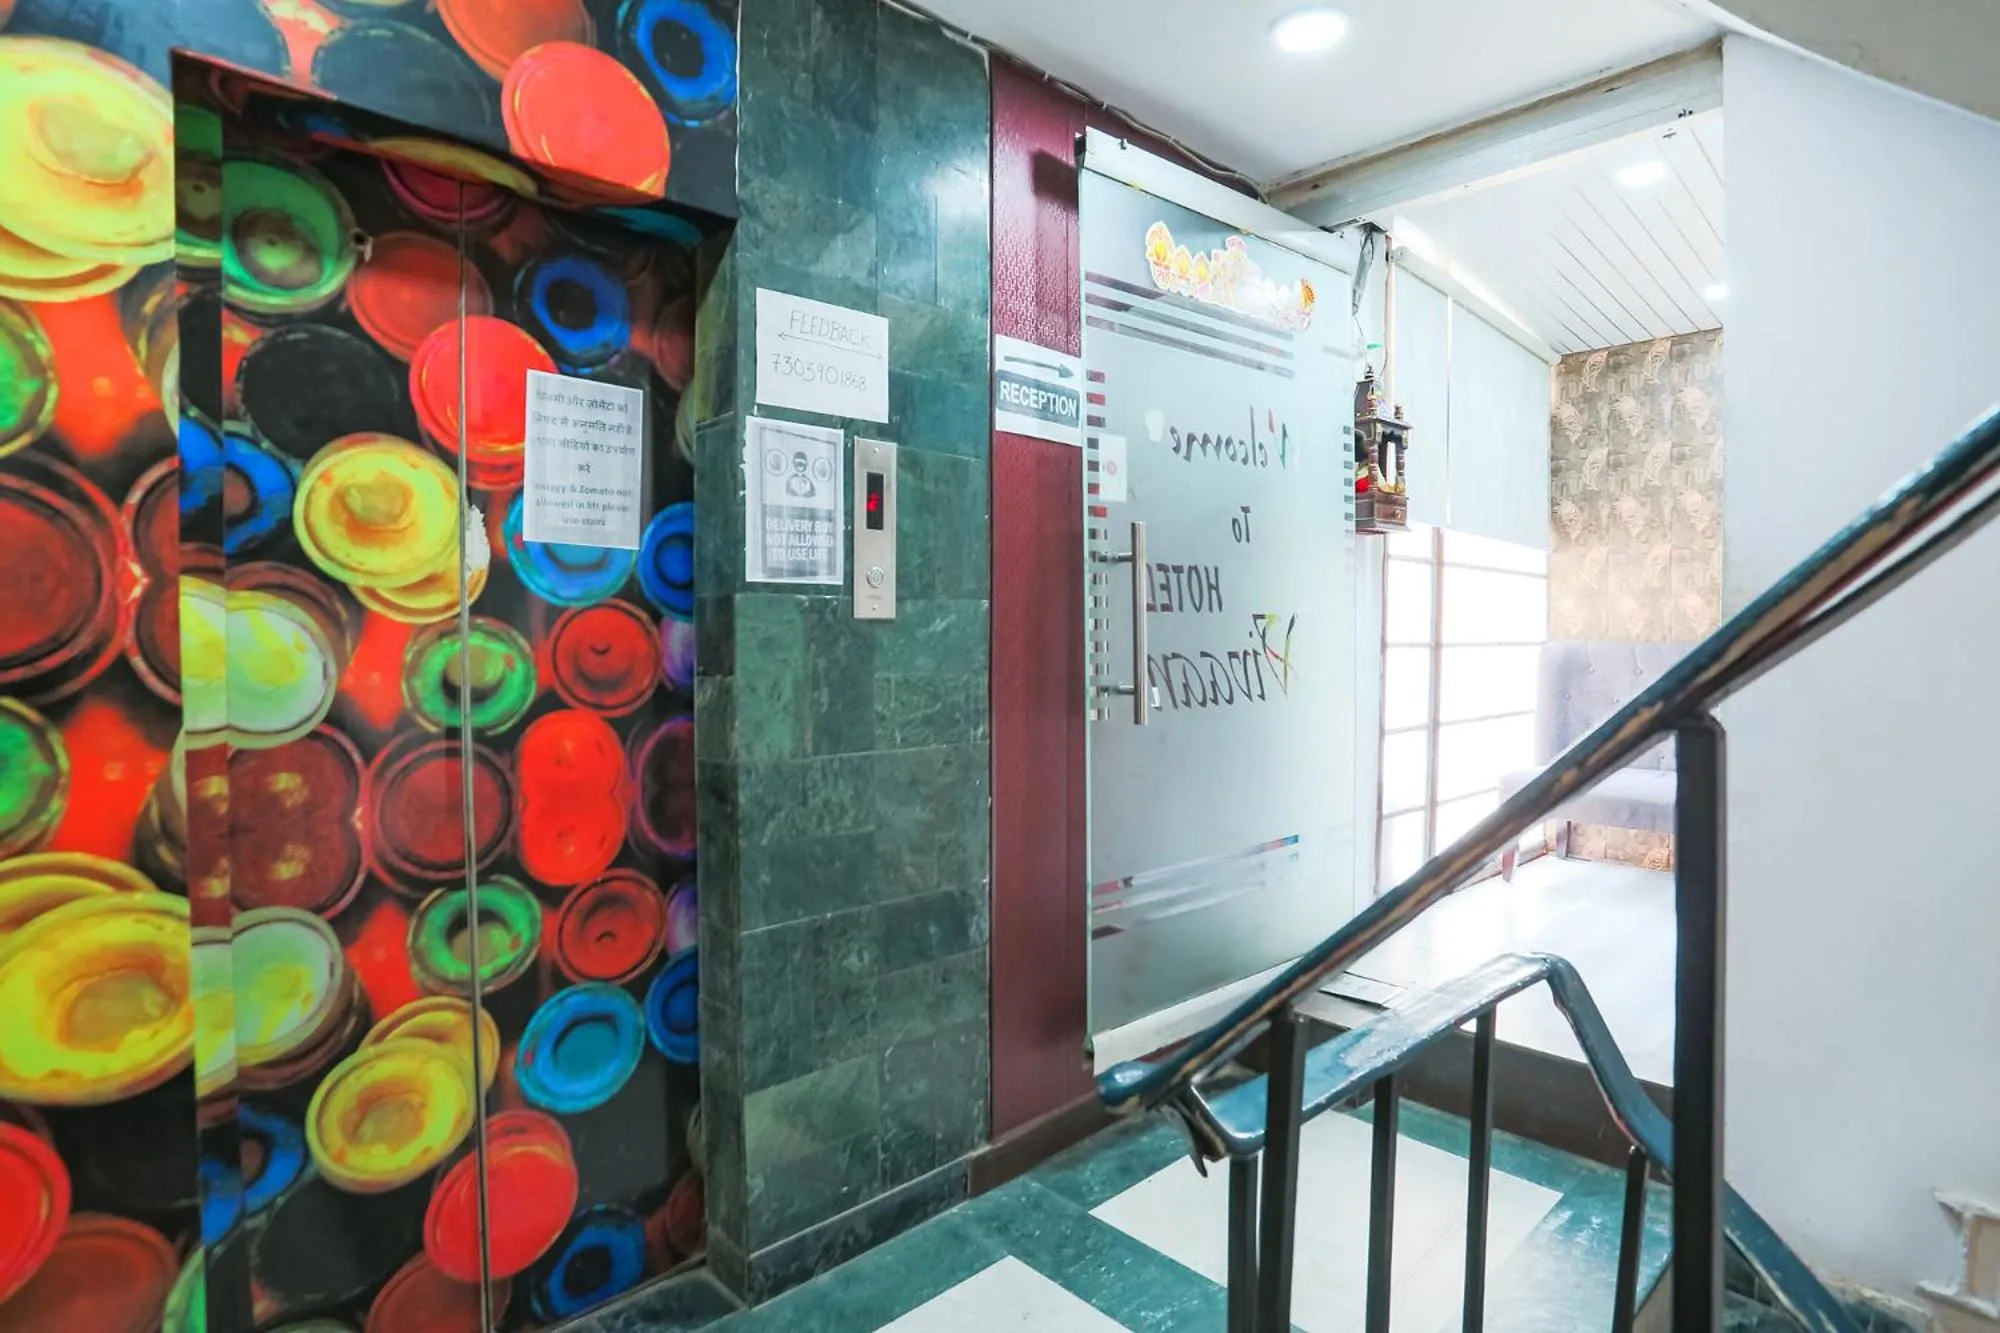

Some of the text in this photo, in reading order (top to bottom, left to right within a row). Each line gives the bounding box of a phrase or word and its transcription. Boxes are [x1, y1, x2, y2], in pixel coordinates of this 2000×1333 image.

[790, 309, 871, 347] FEEDBACK
[1000, 381, 1077, 420] RECEPTION
[579, 485, 615, 496] Zomato
[582, 517, 606, 526] stairs
[766, 518, 813, 532] DELIVERY
[766, 532, 833, 547] NOT ALLOWED
[772, 548, 786, 562] TO
[788, 547, 808, 561] USE
